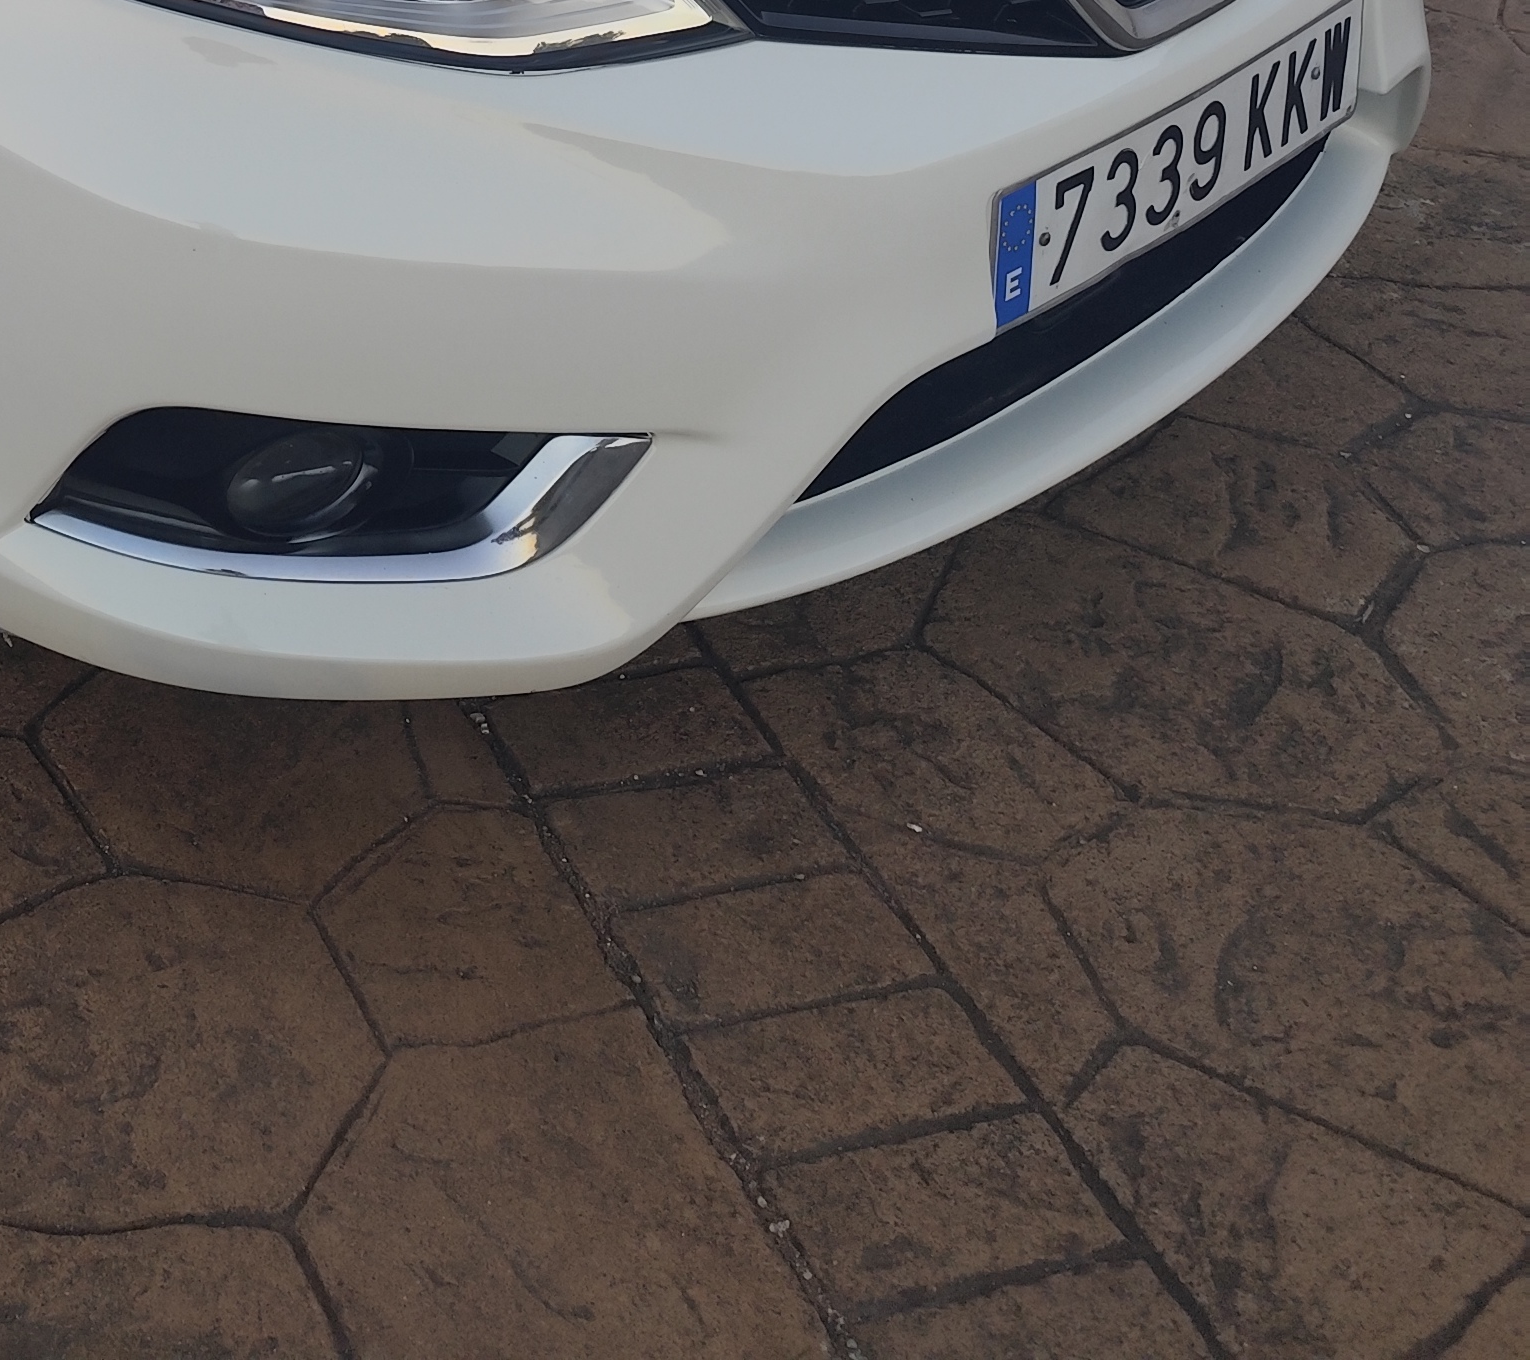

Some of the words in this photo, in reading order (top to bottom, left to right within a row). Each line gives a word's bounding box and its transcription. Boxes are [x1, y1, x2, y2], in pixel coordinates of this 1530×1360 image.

[1049, 101, 1226, 286] 7339
[1244, 16, 1351, 171] KKW
[1004, 266, 1023, 301] E
